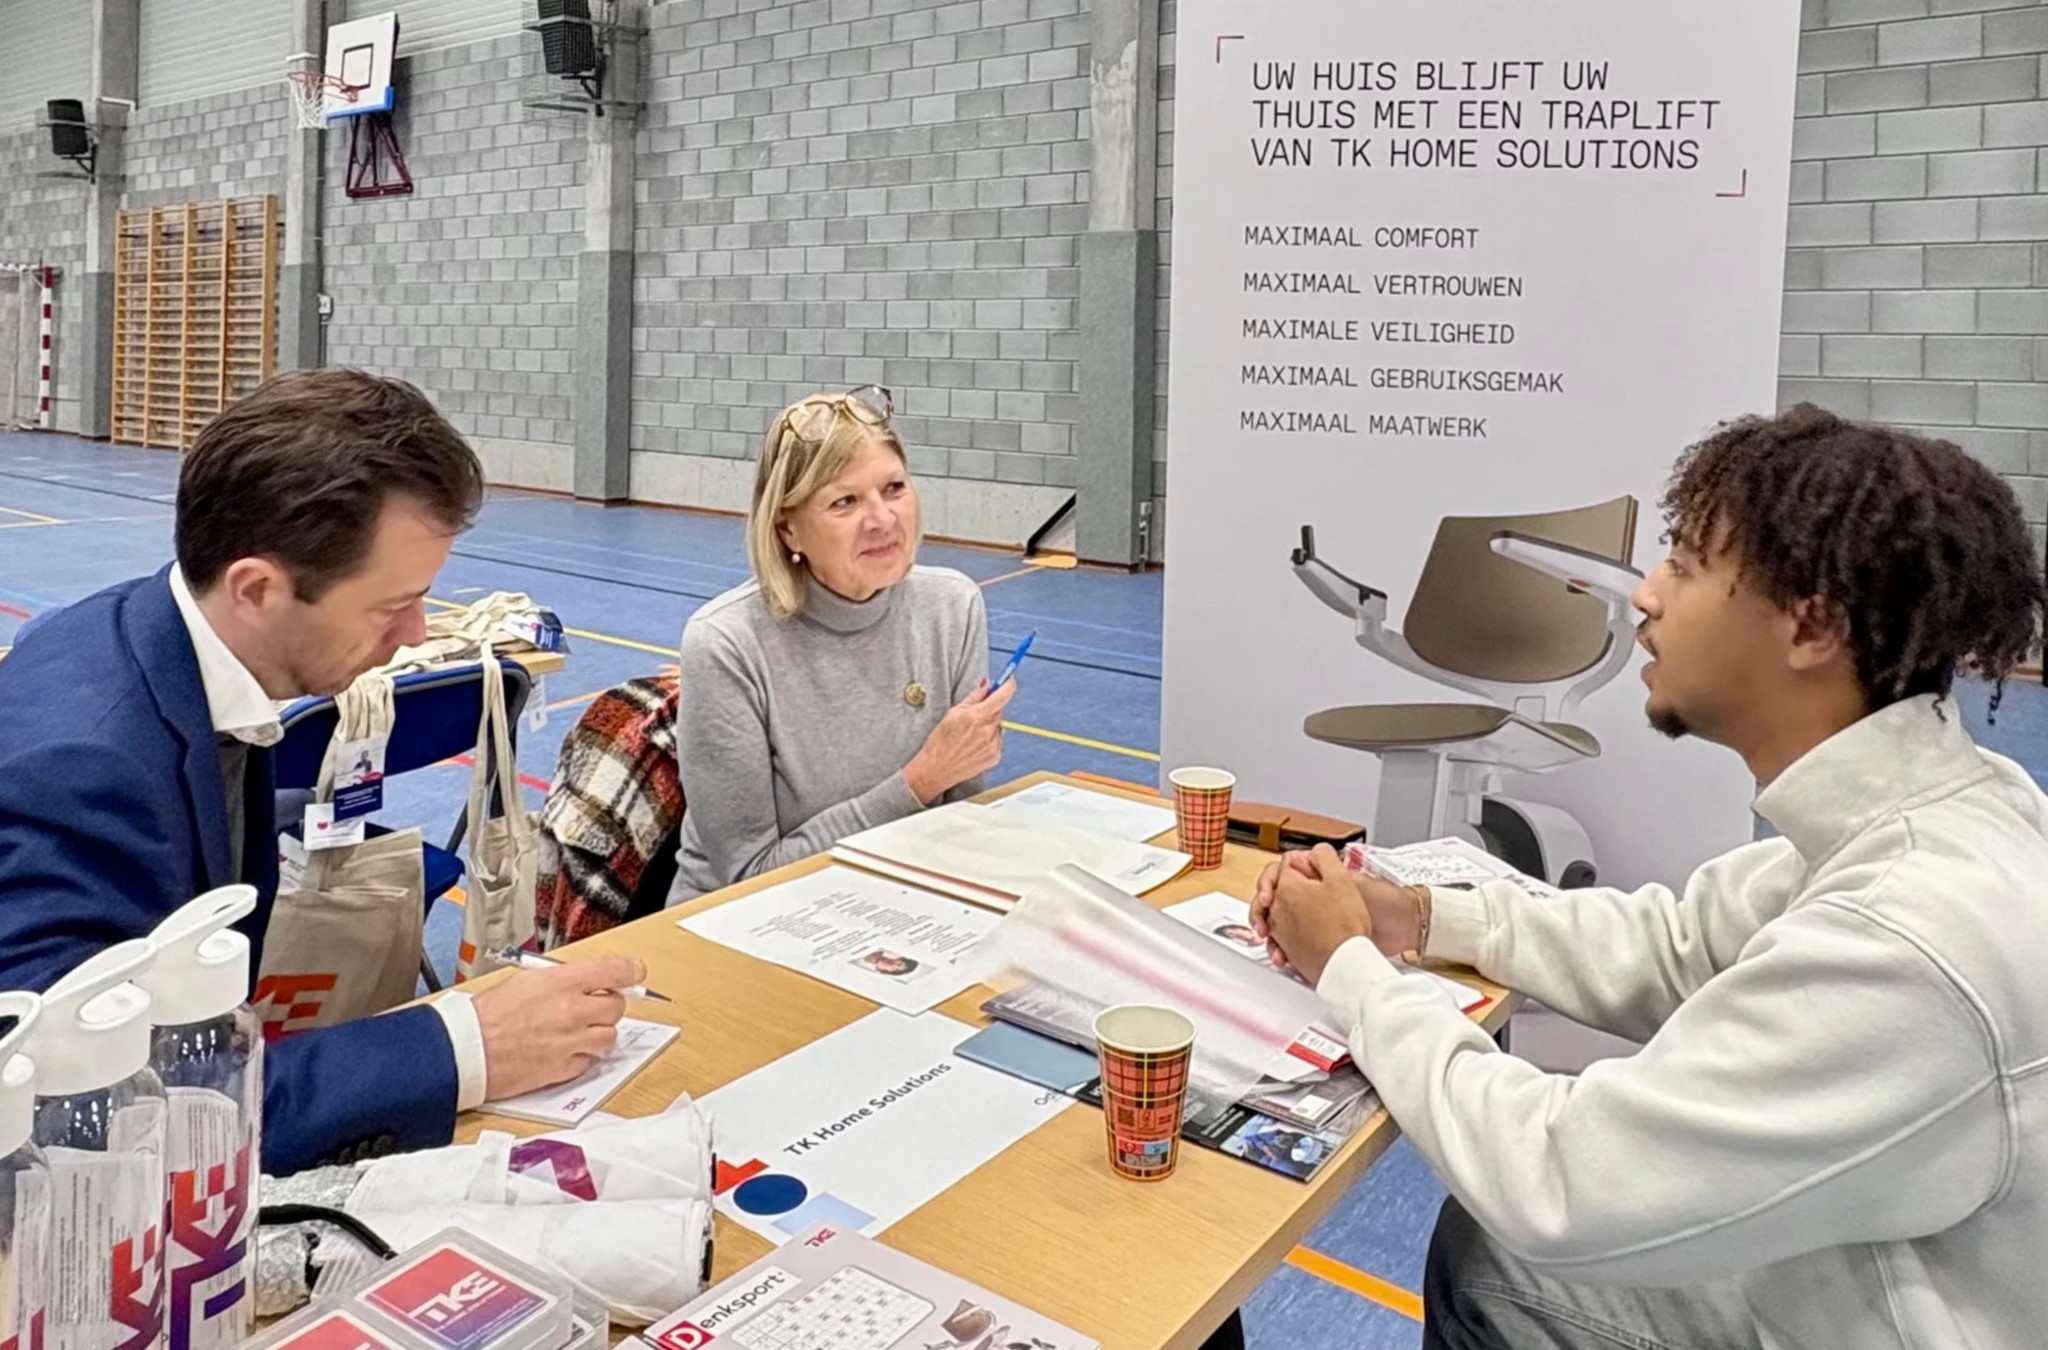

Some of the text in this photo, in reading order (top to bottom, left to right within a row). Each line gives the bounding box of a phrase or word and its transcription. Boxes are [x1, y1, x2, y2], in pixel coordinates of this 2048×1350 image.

[1253, 61, 1608, 91] UW HUIS BLIJFT UW
[1252, 100, 1721, 130] THUIS MET EEN TRAPLIFT
[1251, 138, 1699, 169] VAN TK HOME SOLUTIONS
[1245, 226, 1479, 248] MAXIMAAL COMFORT
[1244, 273, 1522, 297] MAXIMAAL VERTROUWEN
[1243, 319, 1514, 344] MAXIMALE VEILIGHEID
[1242, 365, 1563, 392] MAXIMAAL GEBRUIKSGEMAK
[1241, 411, 1486, 437] MAXIMAAL MAATWERK
[783, 1062, 951, 1156] TK Home Solutions
[804, 1228, 836, 1247] TKE
[407, 1271, 499, 1323] TKE
